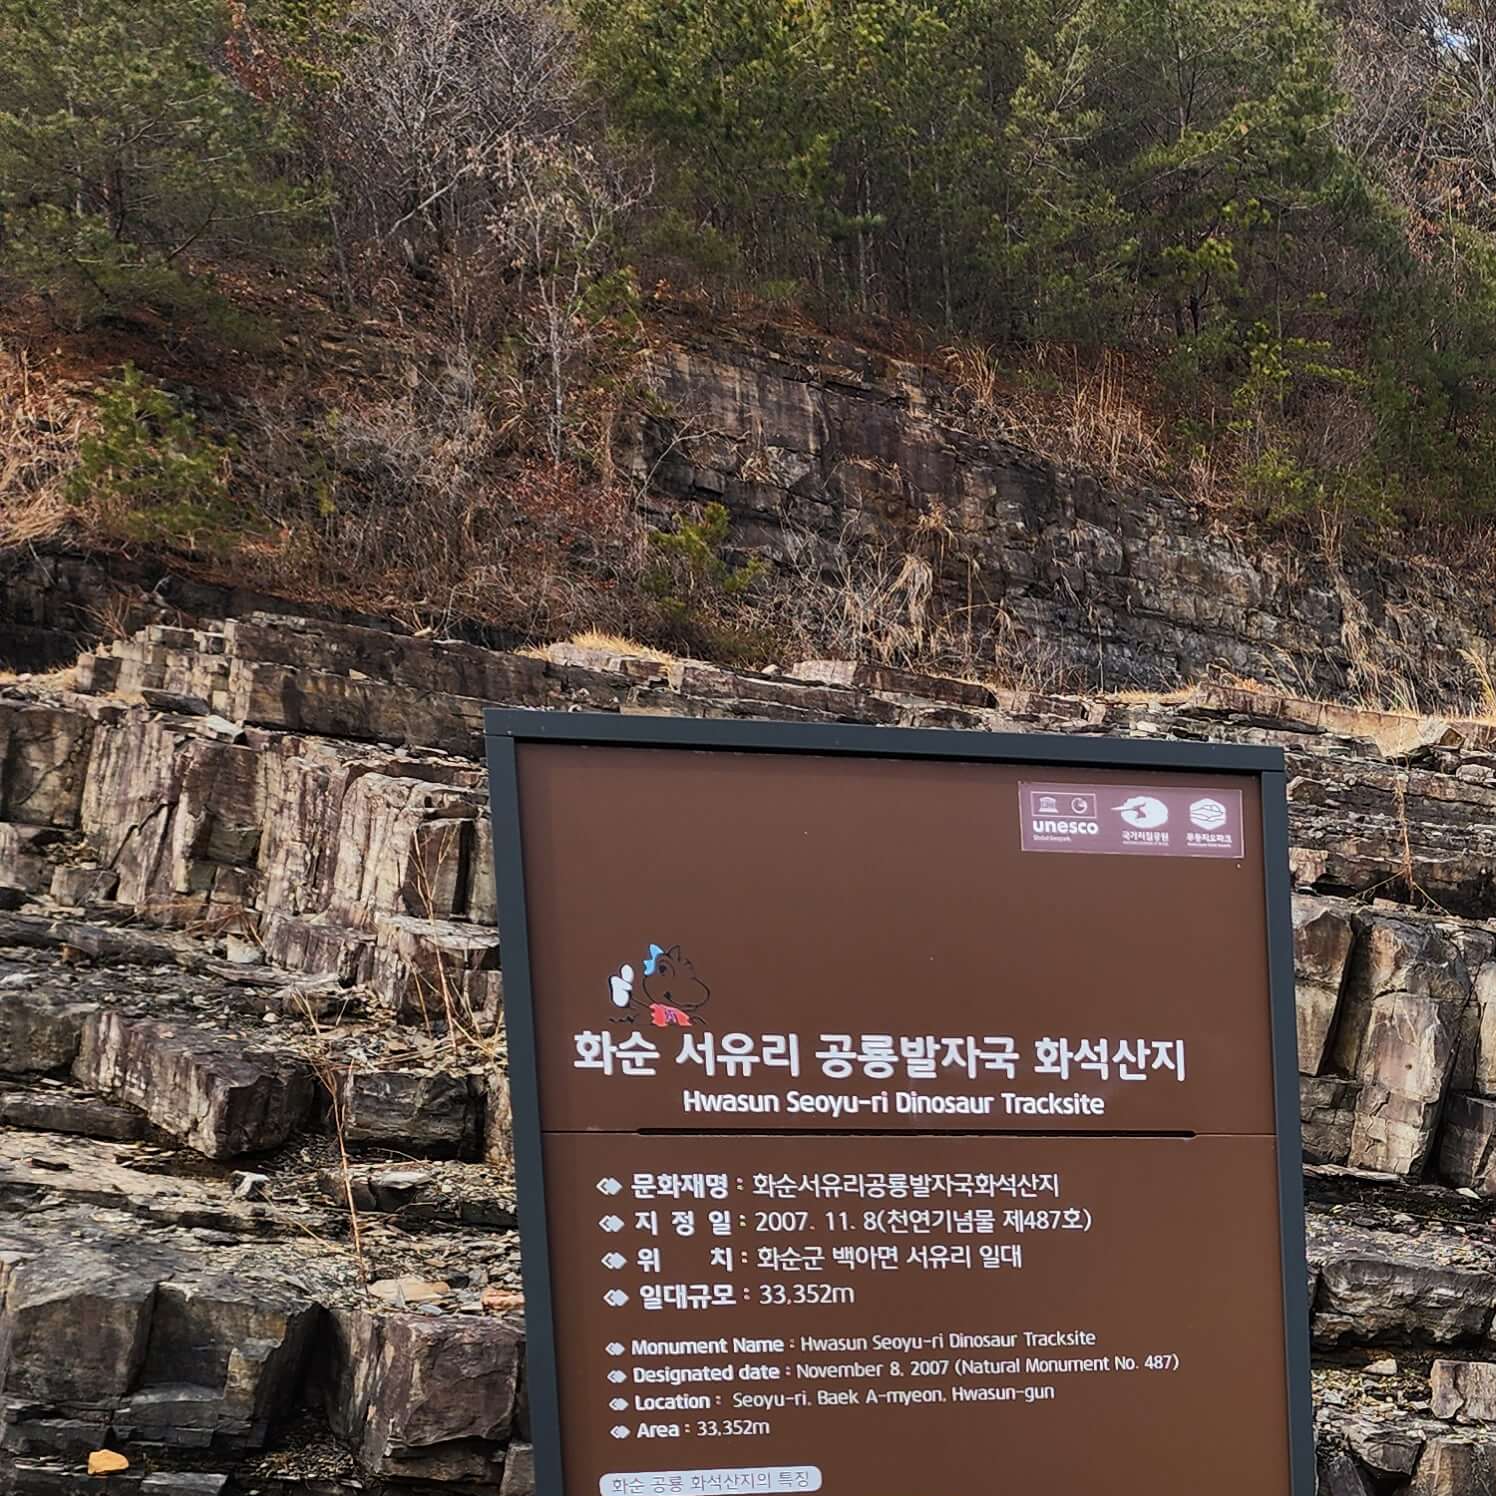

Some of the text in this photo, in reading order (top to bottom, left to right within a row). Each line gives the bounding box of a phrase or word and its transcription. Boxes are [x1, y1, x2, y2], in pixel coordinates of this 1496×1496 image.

[1032, 819, 1099, 835] unesco
[574, 1031, 1184, 1080] 화순 서유리 공룡발자국 화석산지
[684, 1090, 1104, 1116] Hwasun Seoyu-ri Dinosaur Tracksite
[631, 1173, 1058, 1198] 문화재명 화순서유리공룡발자국화석산지
[755, 1211, 814, 1231] 2007.
[826, 1211, 854, 1230] 11.
[864, 1209, 995, 1233] 8(천연기념물
[1003, 1208, 1090, 1231] 제487호)
[757, 1246, 824, 1270] 화순군
[832, 1246, 897, 1269] 백아면
[906, 1245, 970, 1268] 서유리
[979, 1244, 1021, 1268] 일대
[640, 1284, 736, 1309] 일대규모
[632, 1330, 1095, 1354] Monument Name Hwasun Seoyu-ri Dinosaur Tracksite
[633, 1365, 733, 1384] Designated
[738, 1364, 780, 1379] date
[796, 1362, 882, 1377] November
[910, 1359, 948, 1375] 2007
[955, 1358, 1019, 1375] (Natural
[1026, 1357, 1109, 1372] Monument
[1115, 1356, 1138, 1369] No.
[1144, 1353, 1178, 1370] 487)
[635, 1393, 710, 1410] Location
[818, 1389, 858, 1404] Baek
[952, 1386, 1054, 1401] Hwasun-gun
[637, 1423, 679, 1437] Area
[612, 1471, 808, 1494] 화순 공룡 화석산지의 특징
